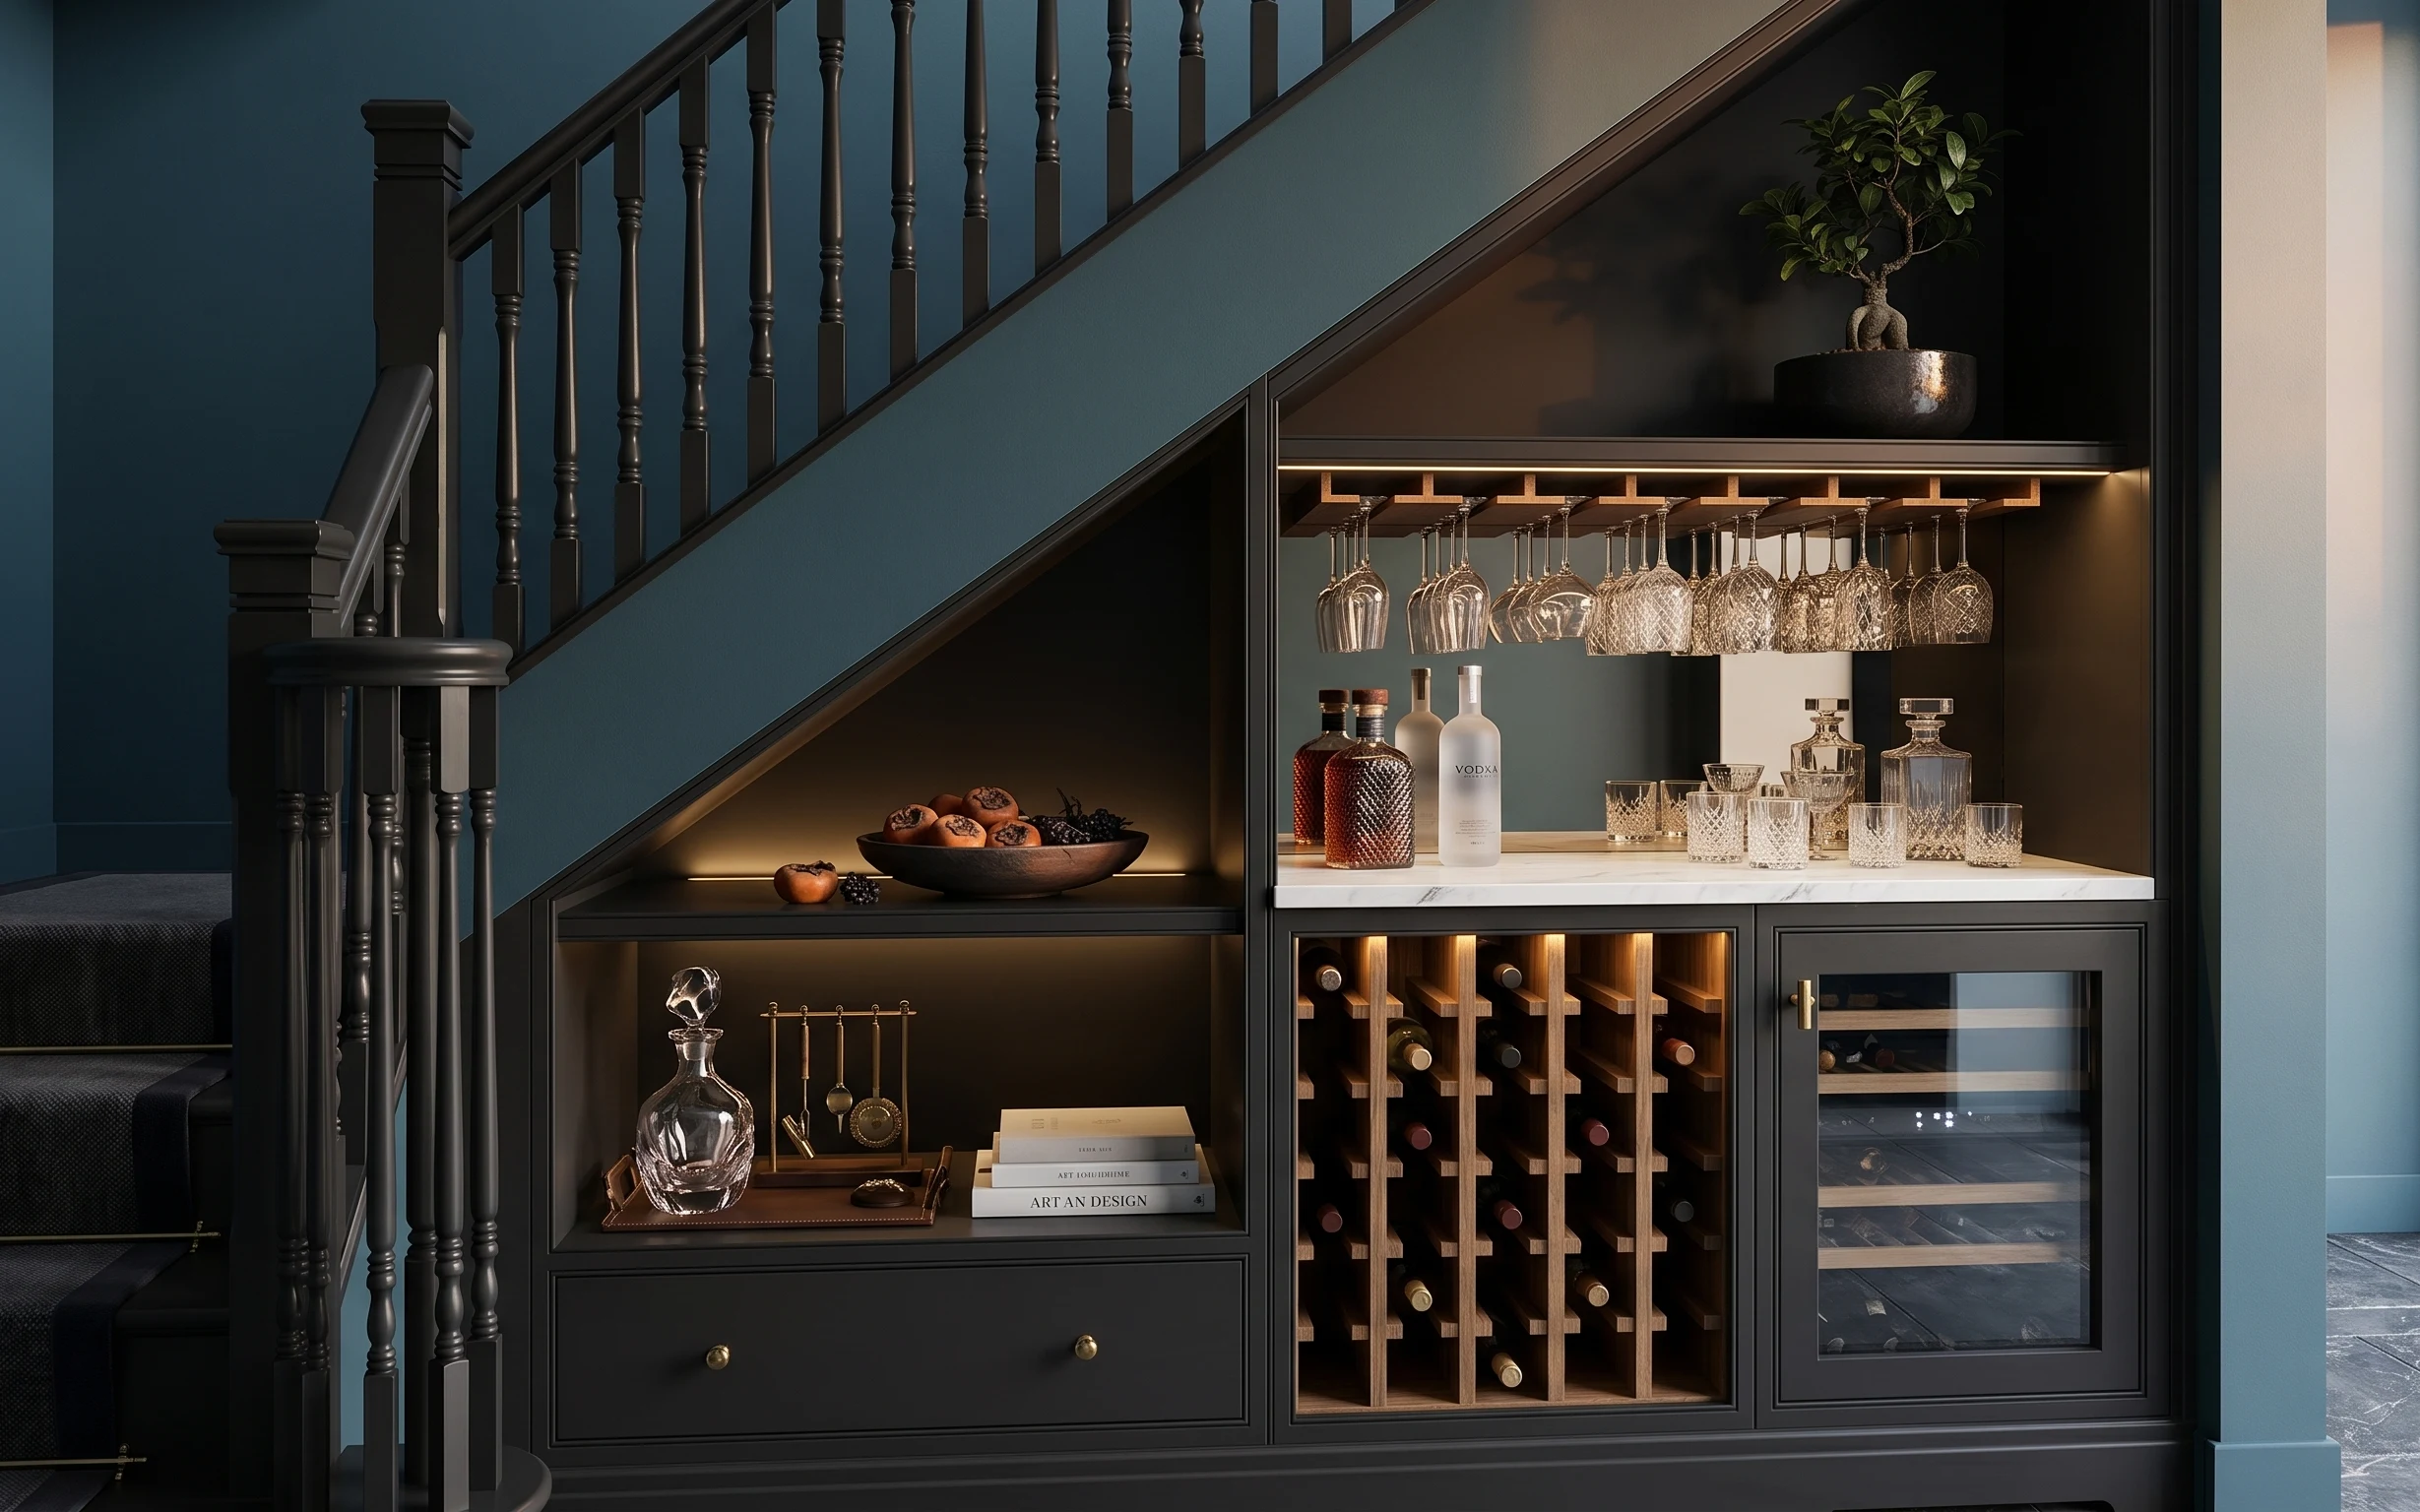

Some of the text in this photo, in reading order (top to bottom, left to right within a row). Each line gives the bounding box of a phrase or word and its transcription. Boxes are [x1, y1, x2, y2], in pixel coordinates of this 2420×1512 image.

[1030, 1194, 1148, 1209] ART AN DESIGN
